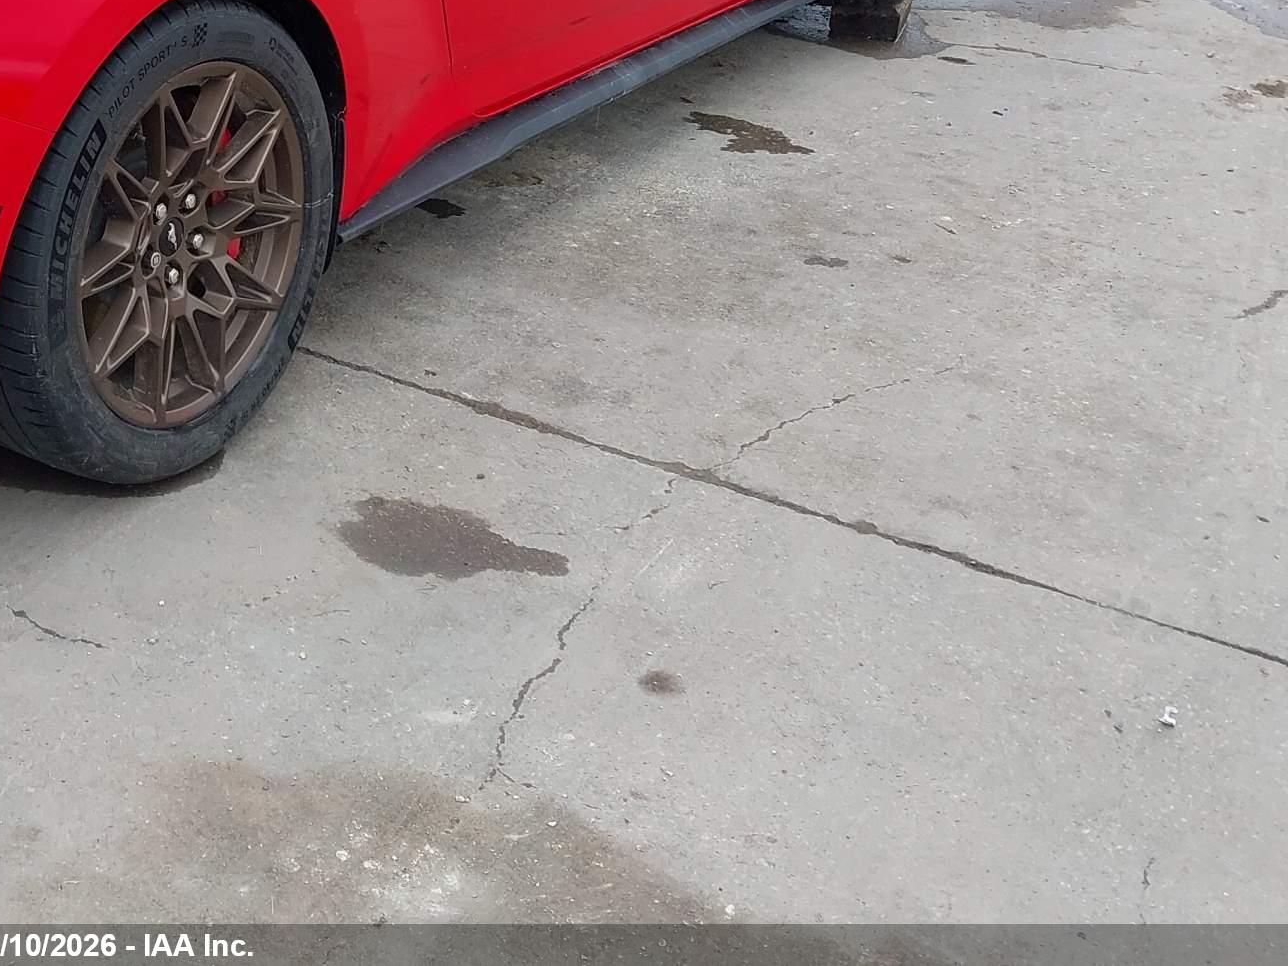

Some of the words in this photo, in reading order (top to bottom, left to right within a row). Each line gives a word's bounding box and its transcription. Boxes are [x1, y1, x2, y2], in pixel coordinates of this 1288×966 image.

[108, 78, 136, 119] PILOT
[138, 47, 172, 82] SPORT
[50, 130, 103, 300] MICHELIN
